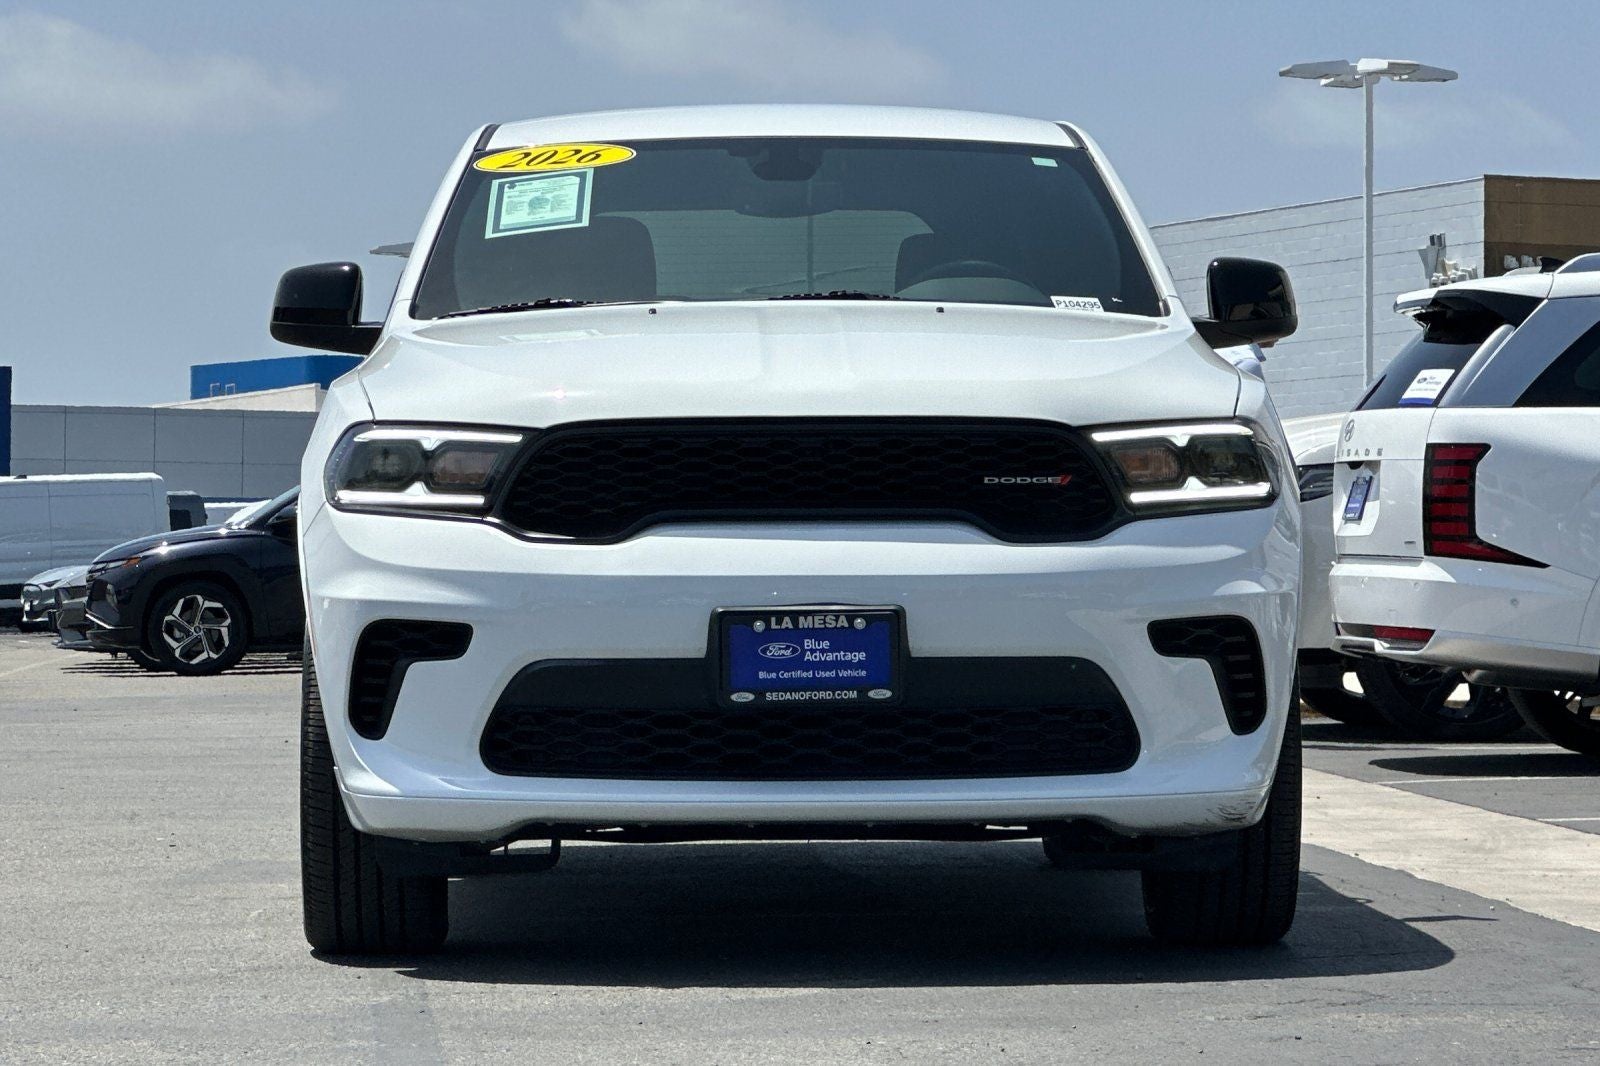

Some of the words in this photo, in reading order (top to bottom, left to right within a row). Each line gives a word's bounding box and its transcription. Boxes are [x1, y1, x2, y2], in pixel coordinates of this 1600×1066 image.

[496, 147, 611, 169] 2026
[984, 476, 1062, 484] DODGE
[771, 616, 793, 629] LA
[799, 615, 849, 629] MESA
[766, 644, 793, 656] Ford
[804, 639, 830, 650] Blue
[804, 651, 866, 663] Advantage
[758, 671, 777, 679] Blue
[778, 670, 813, 679] Certified
[815, 669, 836, 678] Used
[837, 668, 867, 677] Vehicle
[765, 690, 858, 701] SEDANOFORD.COM
